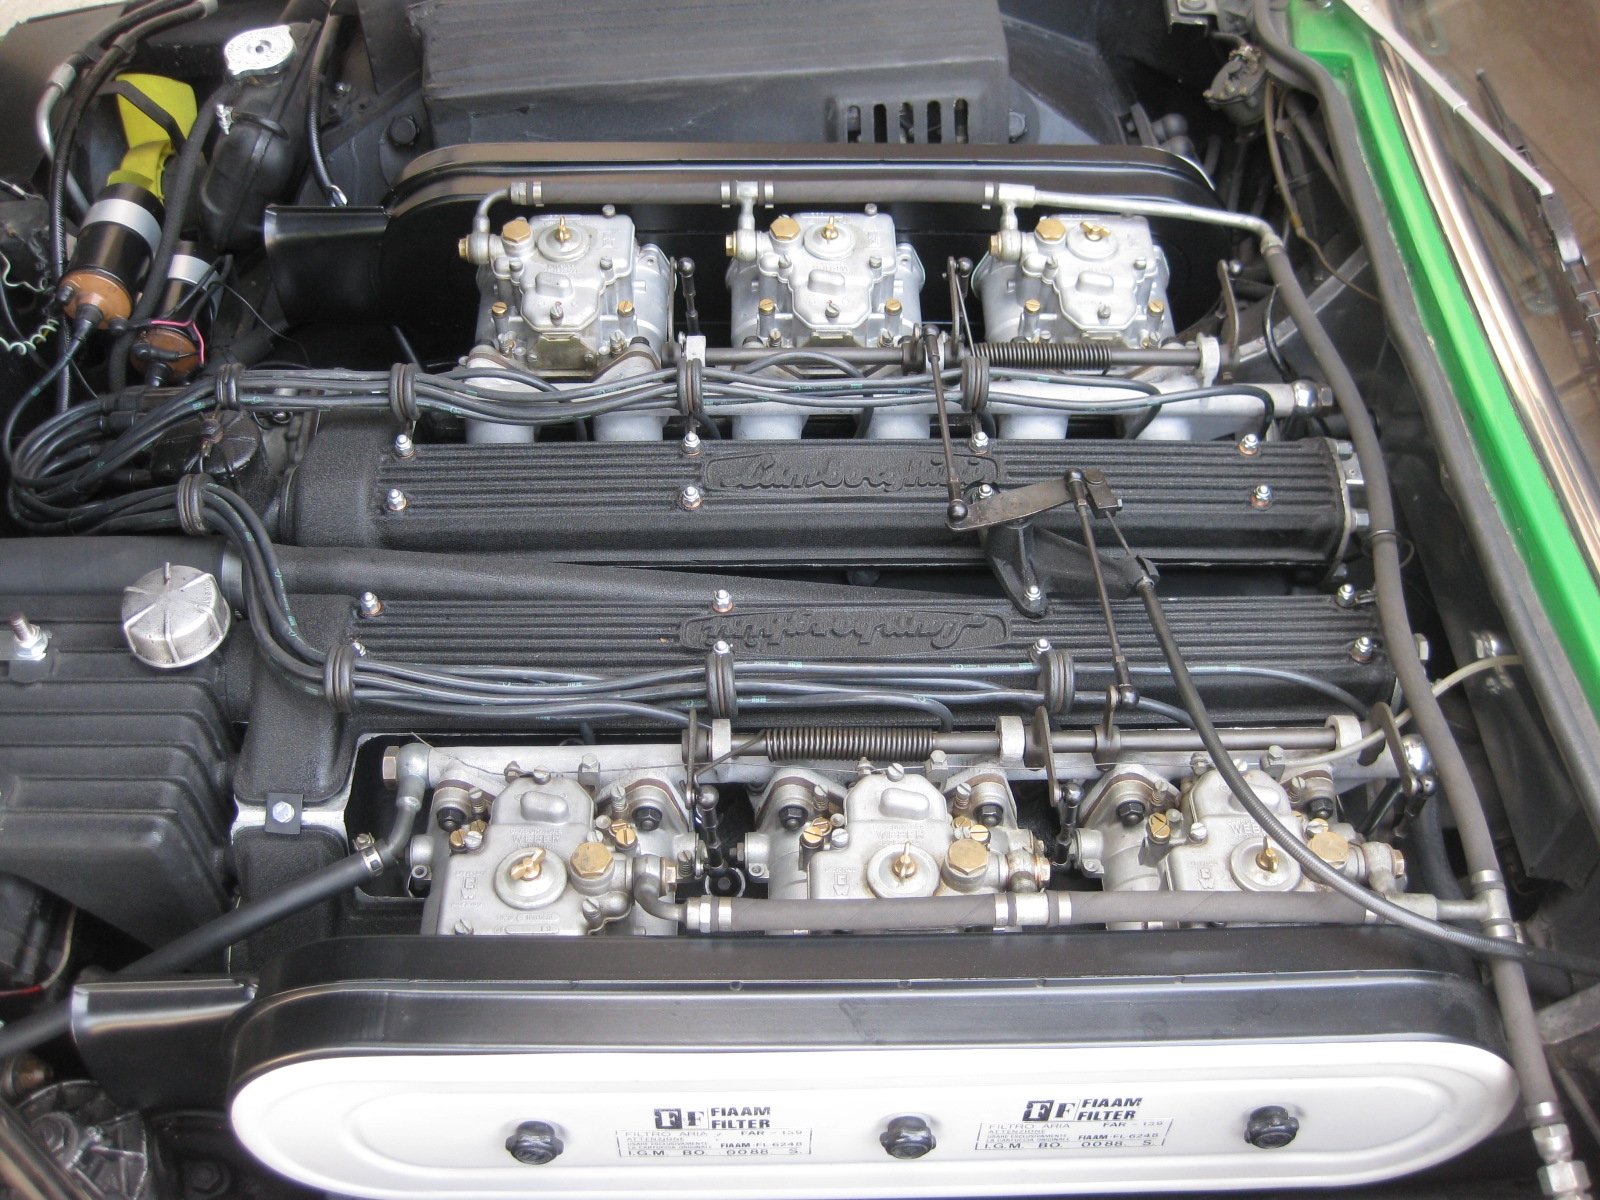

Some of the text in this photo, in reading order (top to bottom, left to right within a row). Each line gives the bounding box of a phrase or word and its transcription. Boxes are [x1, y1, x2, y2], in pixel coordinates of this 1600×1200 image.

[512, 834, 561, 843] WEBER
[1082, 1098, 1143, 1108] FIAAM
[711, 1106, 770, 1117] FIAAM
[1077, 1110, 1136, 1120] FILTER
[711, 1119, 770, 1129] FILTER
